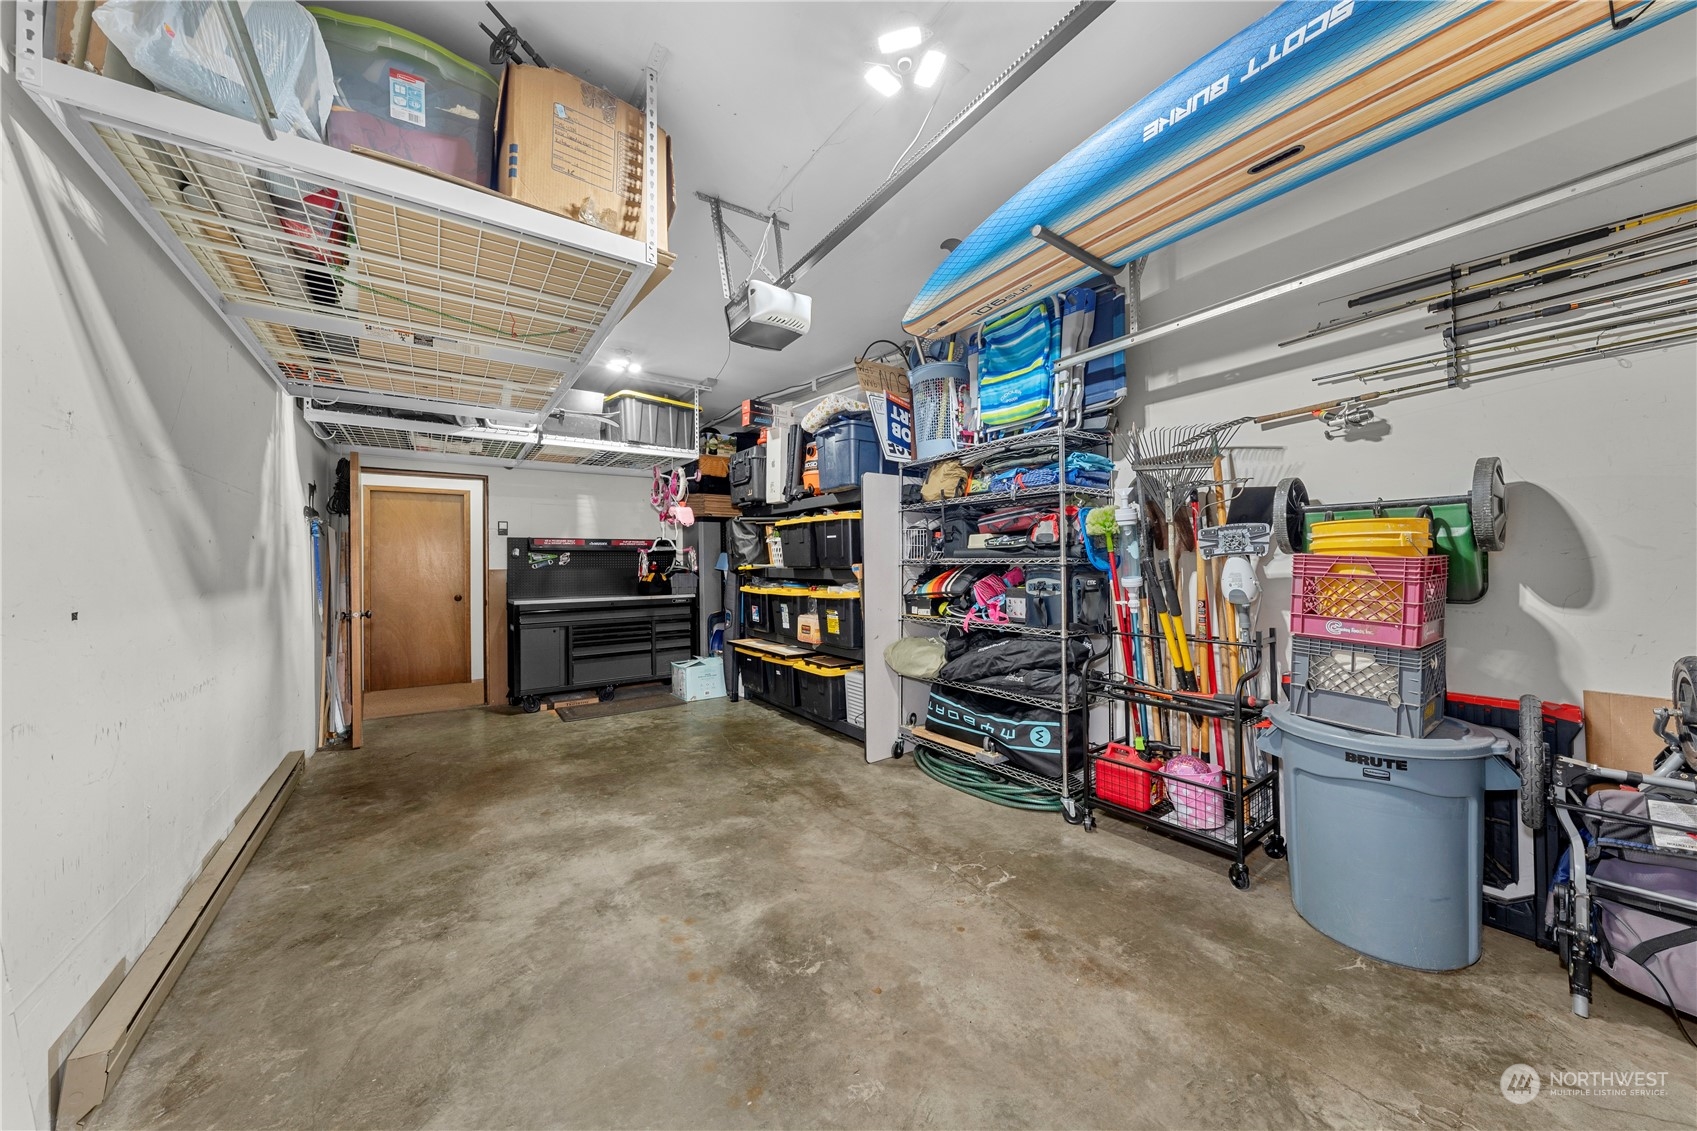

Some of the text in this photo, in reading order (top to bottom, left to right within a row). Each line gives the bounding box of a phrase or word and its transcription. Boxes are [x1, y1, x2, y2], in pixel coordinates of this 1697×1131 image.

[1142, 0, 1355, 143] SCOTT BURKE
[878, 369, 911, 394] SUN
[1000, 389, 1022, 402] COOLER
[890, 405, 911, 427] RT
[1344, 751, 1408, 772] BRUTE
